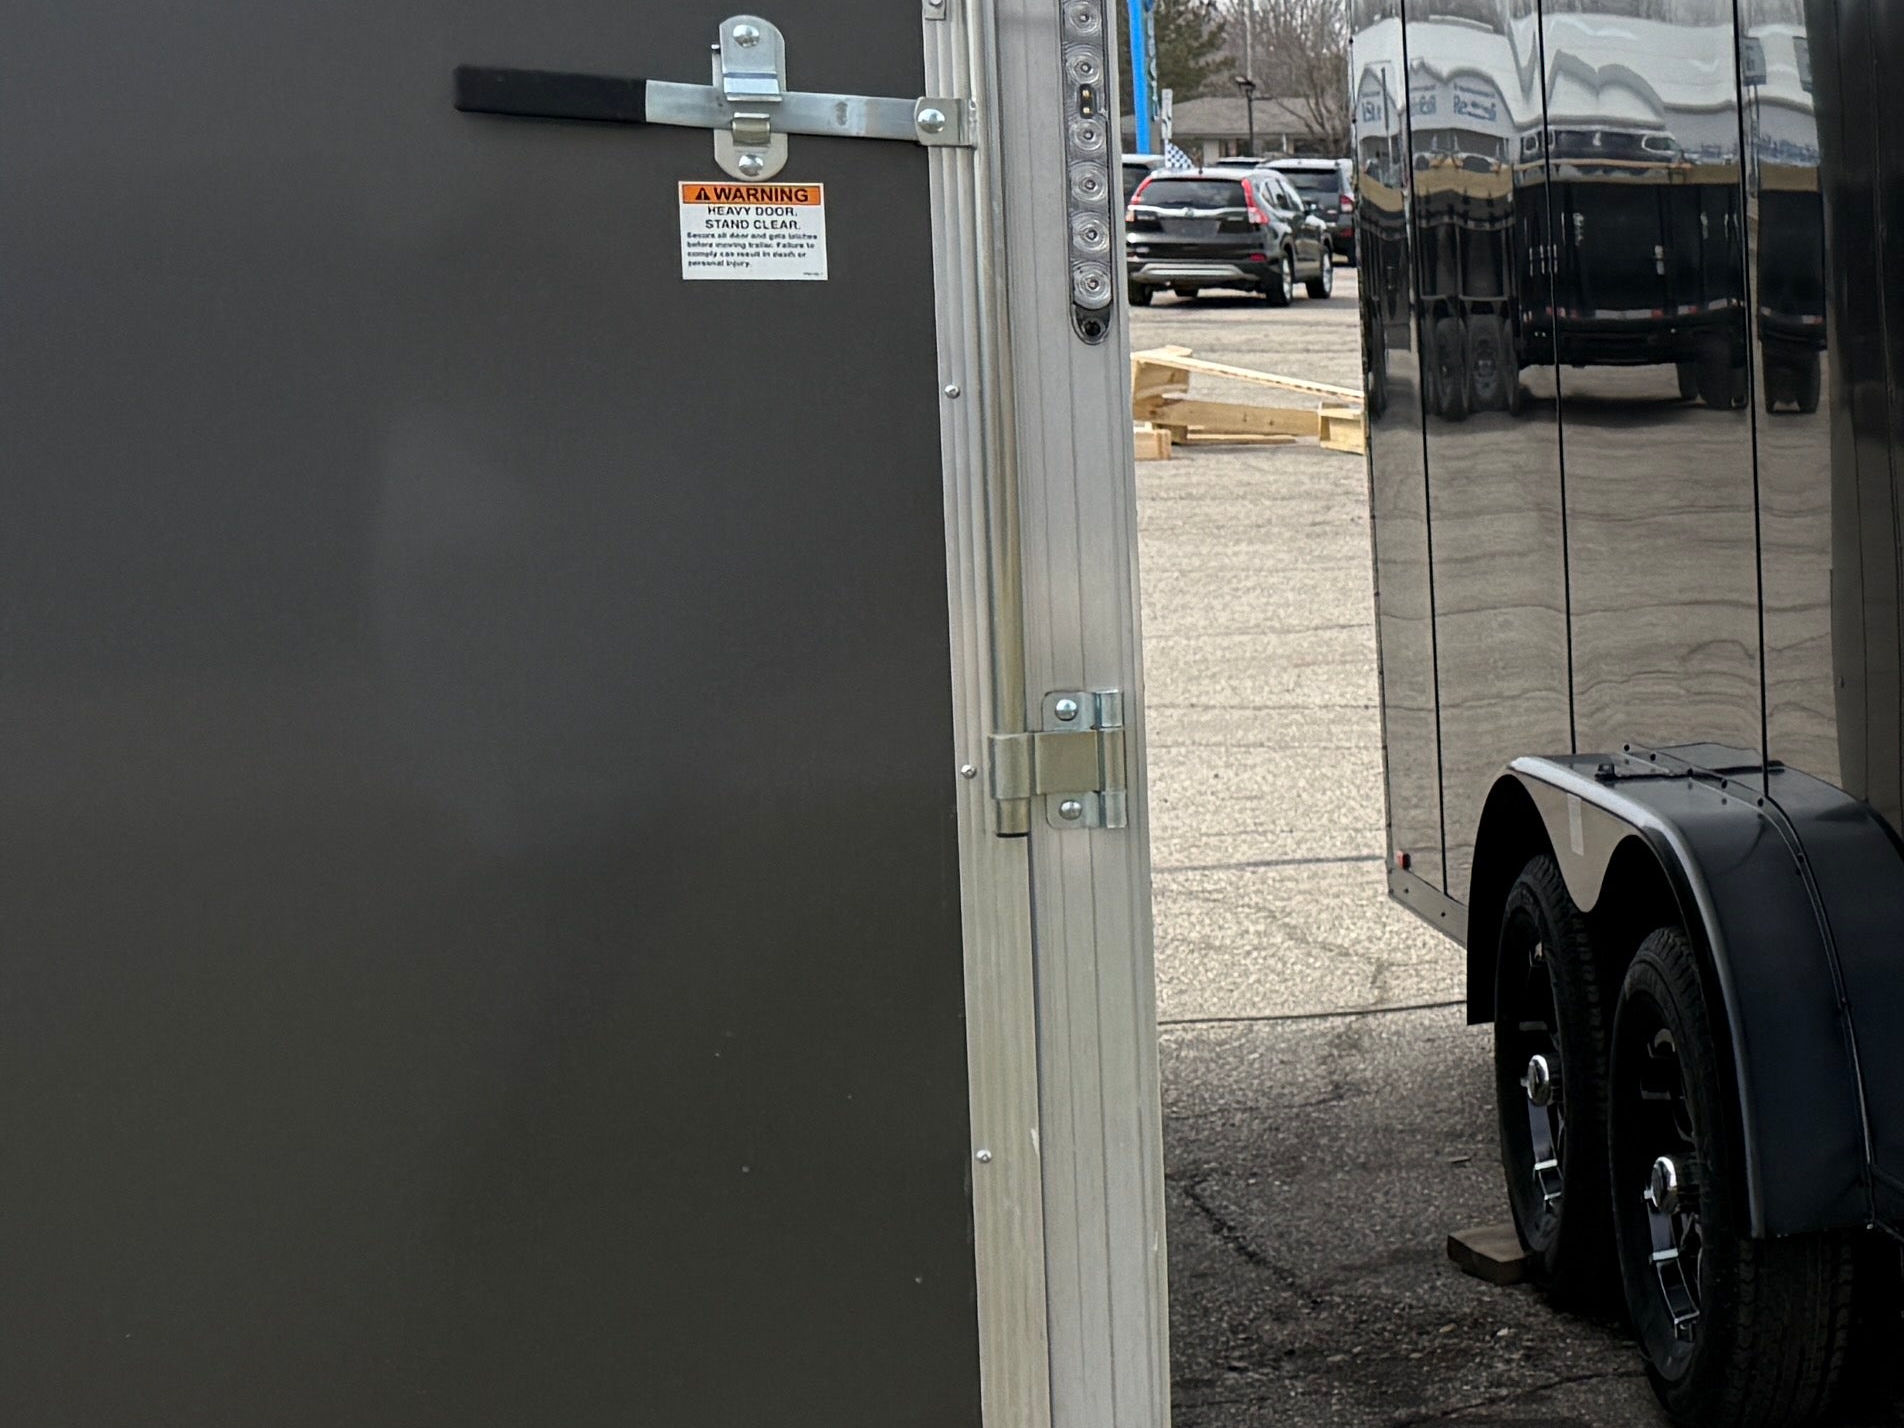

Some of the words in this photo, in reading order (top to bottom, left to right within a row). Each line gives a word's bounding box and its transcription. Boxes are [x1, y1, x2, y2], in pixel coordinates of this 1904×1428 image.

[713, 187, 809, 203] WARNING
[707, 206, 752, 216] HEAVY
[705, 219, 750, 229] STAND
